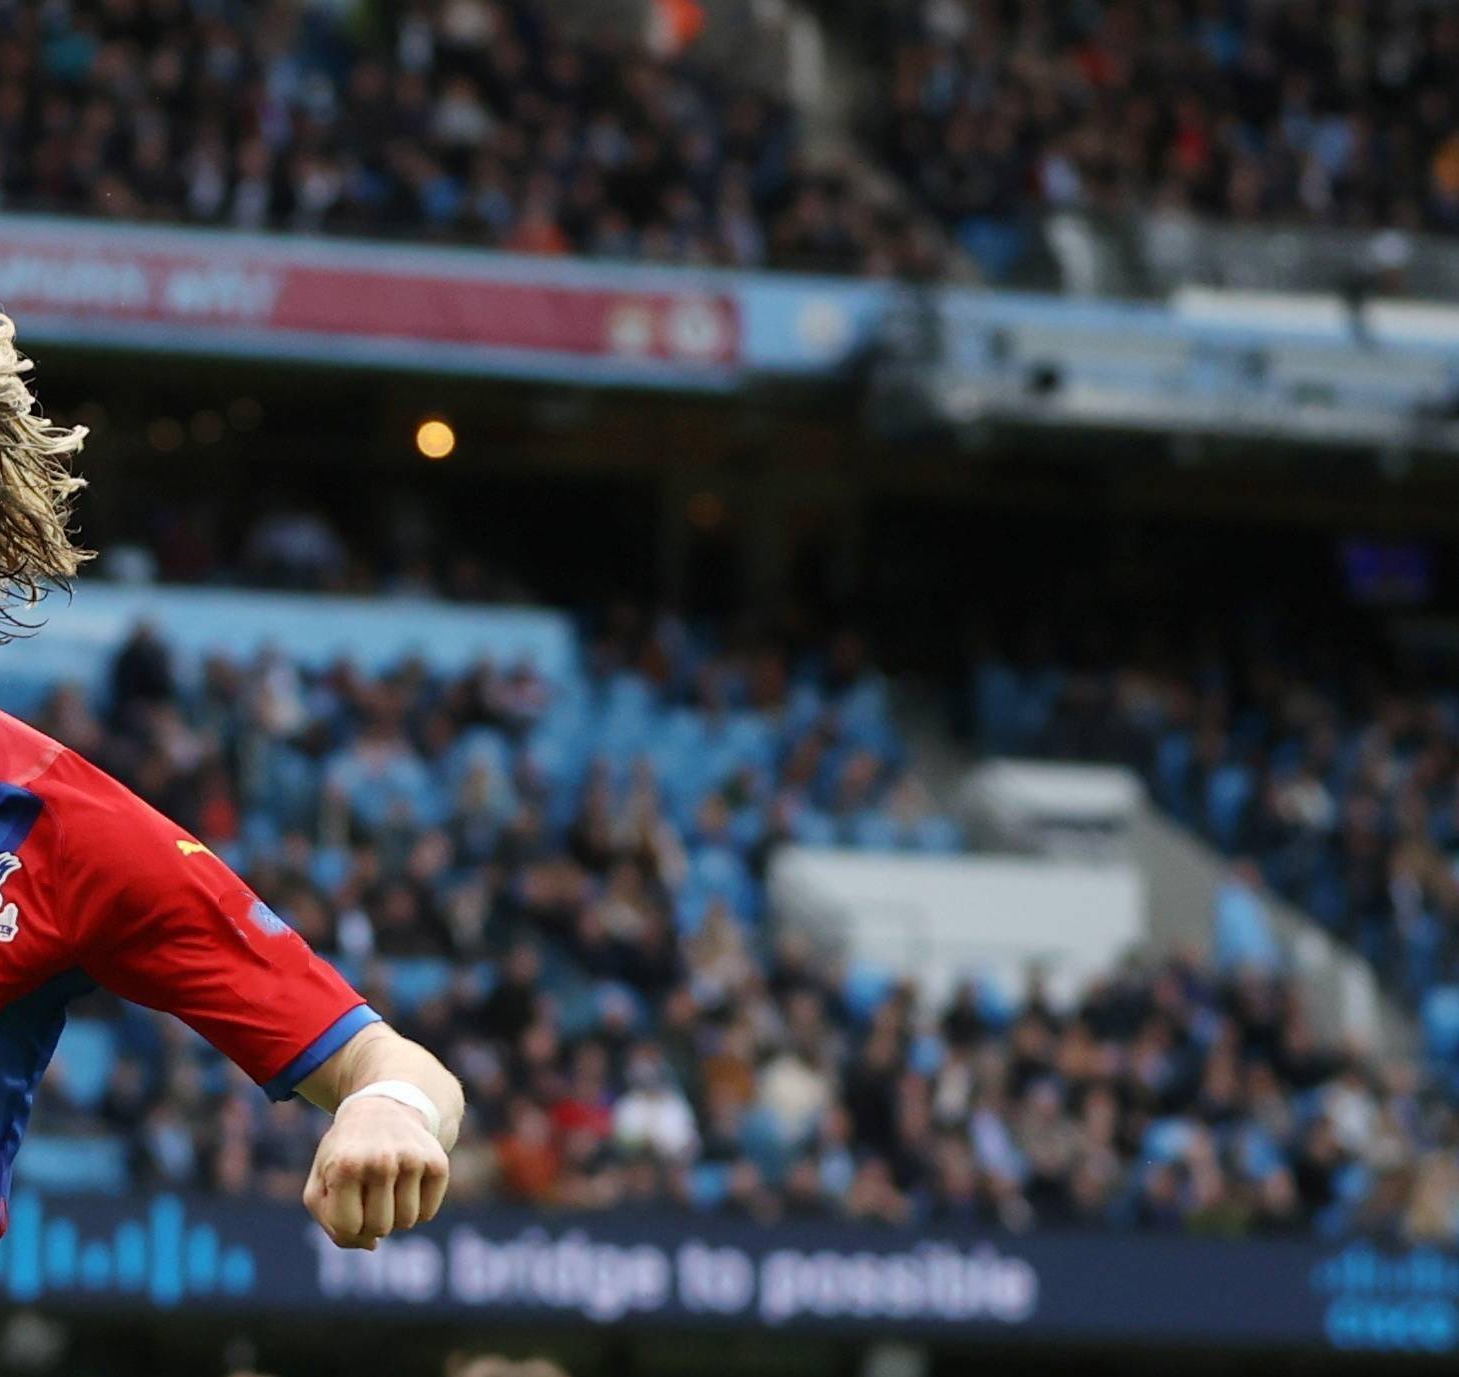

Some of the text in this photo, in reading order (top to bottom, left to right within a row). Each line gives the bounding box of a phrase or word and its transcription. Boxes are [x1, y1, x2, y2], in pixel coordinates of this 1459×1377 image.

[447, 1228, 670, 1322] bridge
[680, 1240, 755, 1313] to
[760, 1242, 1039, 1325] possible
